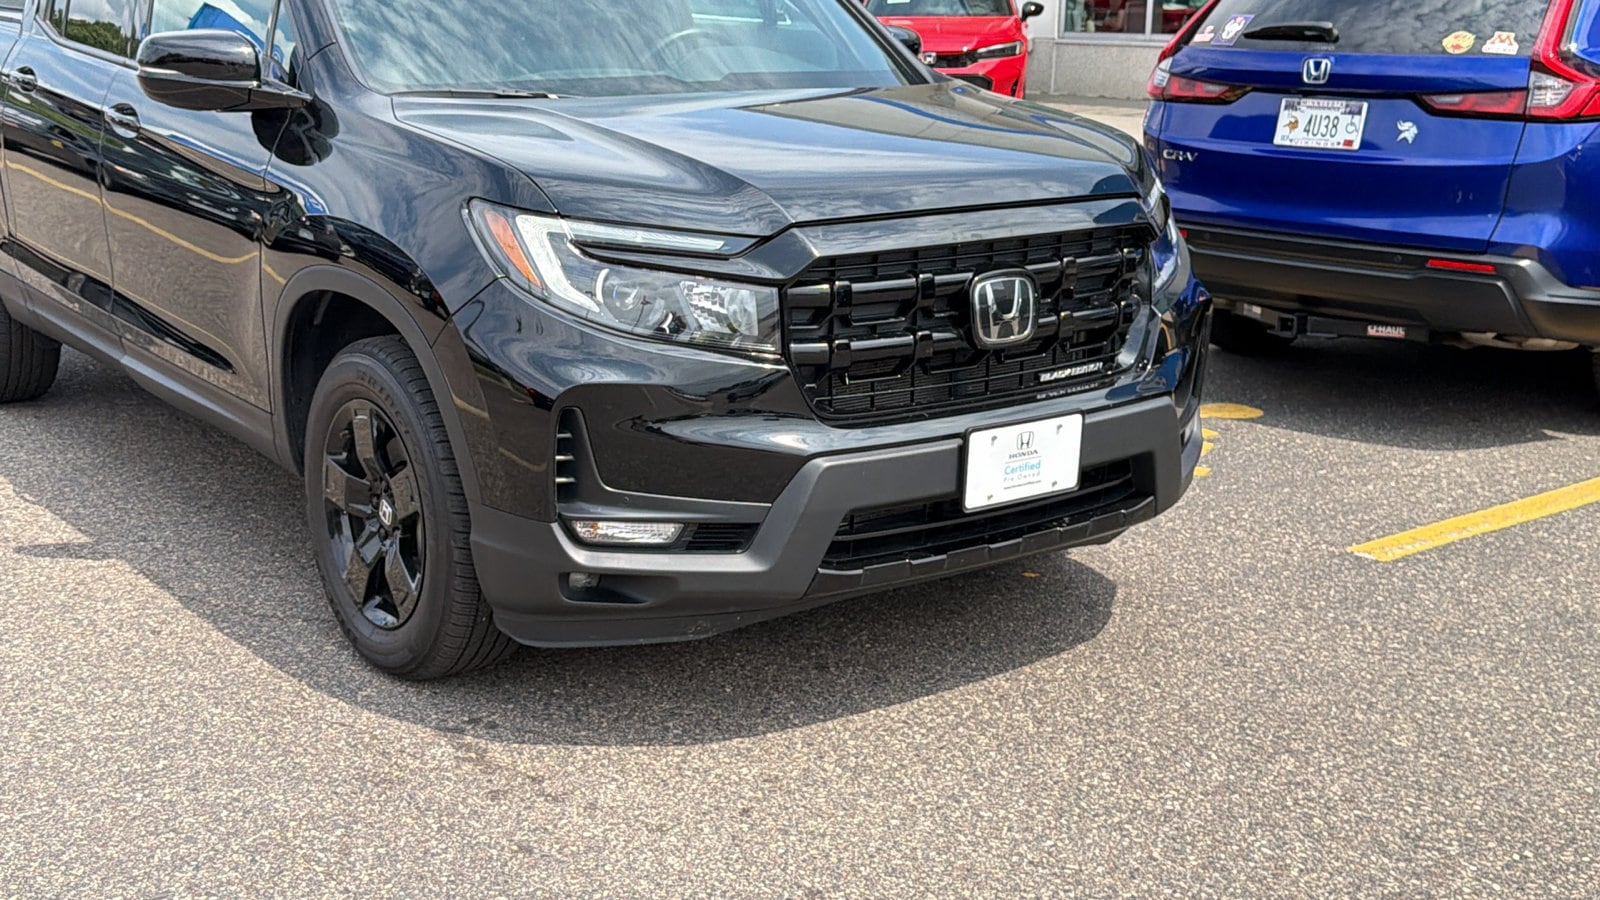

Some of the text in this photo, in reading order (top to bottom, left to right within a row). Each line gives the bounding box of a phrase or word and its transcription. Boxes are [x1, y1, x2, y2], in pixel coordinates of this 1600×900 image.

[1303, 114, 1340, 138] 4U38
[1009, 449, 1038, 459] HONDA
[1004, 459, 1041, 475] Certified
